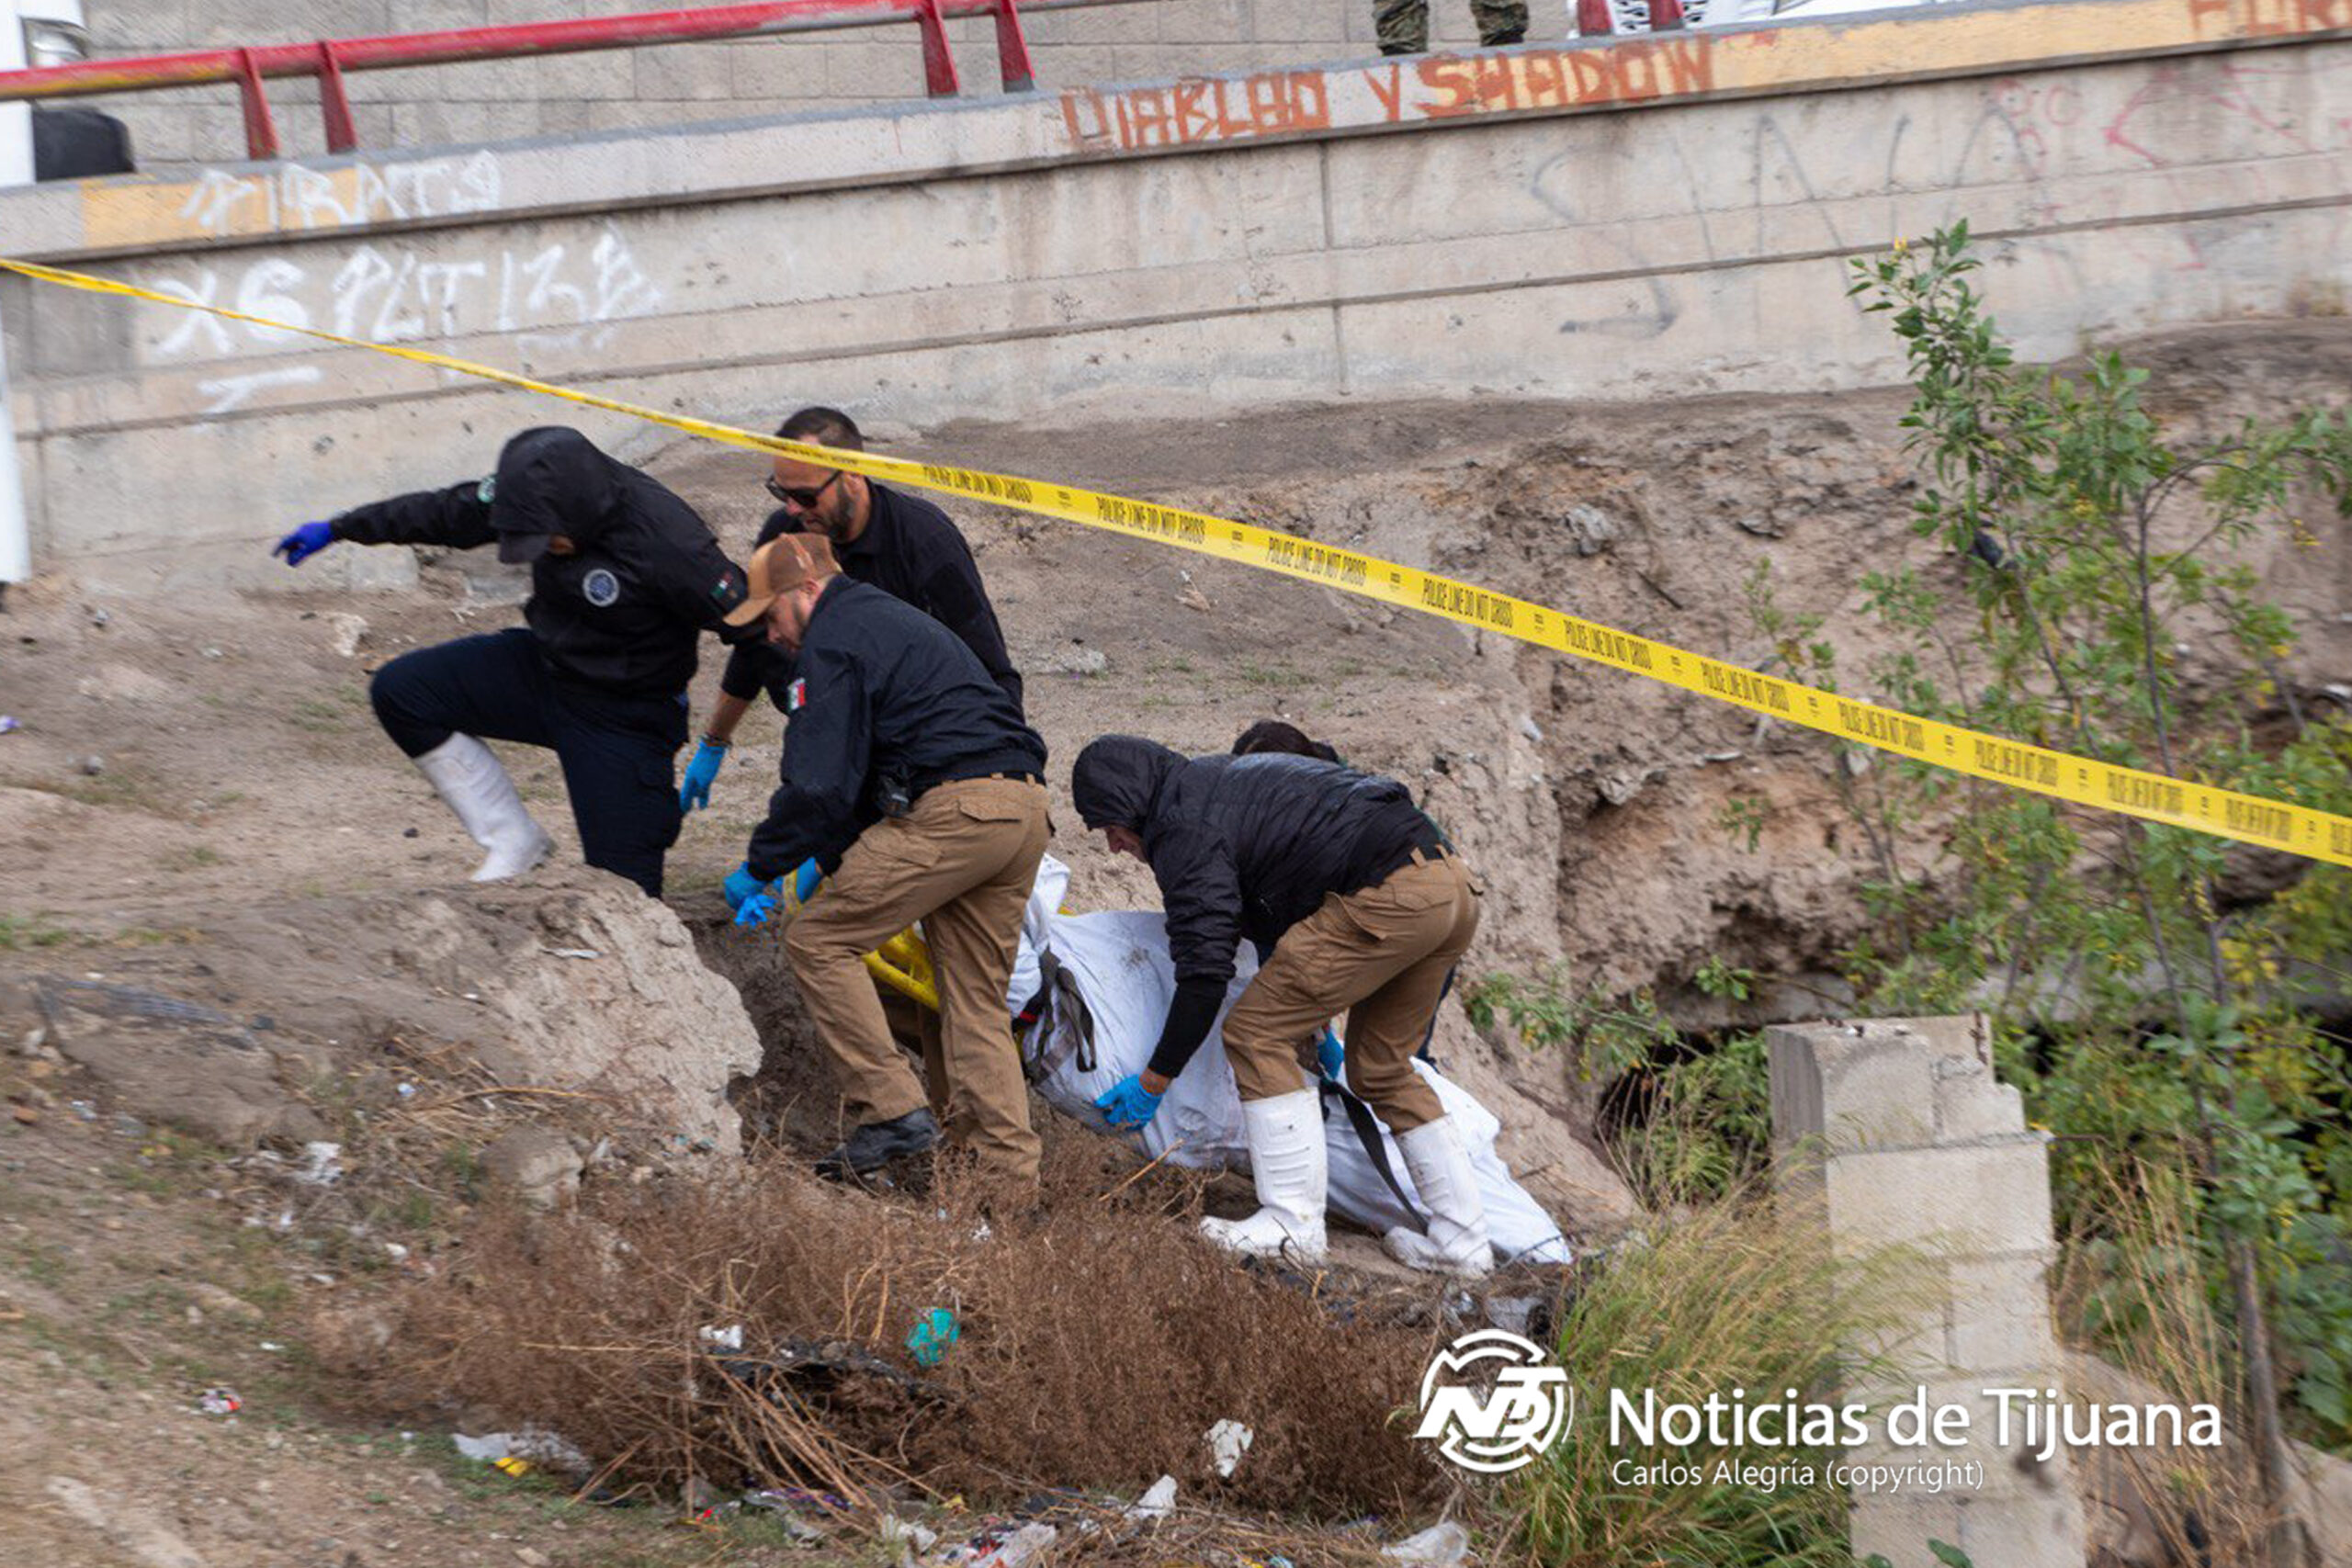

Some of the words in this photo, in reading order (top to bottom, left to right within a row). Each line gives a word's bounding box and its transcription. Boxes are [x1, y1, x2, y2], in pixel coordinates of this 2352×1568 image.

[1413, 32, 1714, 120] SHADOW
[1096, 496, 1125, 525] POLICE
[1128, 503, 1145, 530] LINE
[1147, 507, 1159, 533] DO
[1160, 511, 1176, 538] NOT
[1178, 513, 1205, 544] CROSS
[1266, 536, 1295, 567] POLICE
[1295, 544, 1313, 571] LINE
[1312, 548, 1325, 575] DO
[1325, 551, 1340, 579] NOT
[1341, 555, 1367, 586] CROSS
[1422, 578, 1447, 610] POLICE
[1448, 586, 1464, 614] LINE
[1464, 589, 1475, 616] DO
[1476, 592, 1488, 621] NOT
[1490, 597, 1513, 628] CROSS
[1563, 619, 1589, 651] POLICE
[1589, 626, 1605, 656] LINE
[1602, 631, 1615, 659] DO
[1613, 635, 1629, 662] NOT
[1627, 638, 1652, 670] CROSS
[1701, 660, 1726, 694] POLICE
[1725, 668, 1742, 698] LINE
[1739, 672, 1752, 701] DO
[1751, 677, 1767, 705] NOT
[1765, 680, 1790, 712] CROSS
